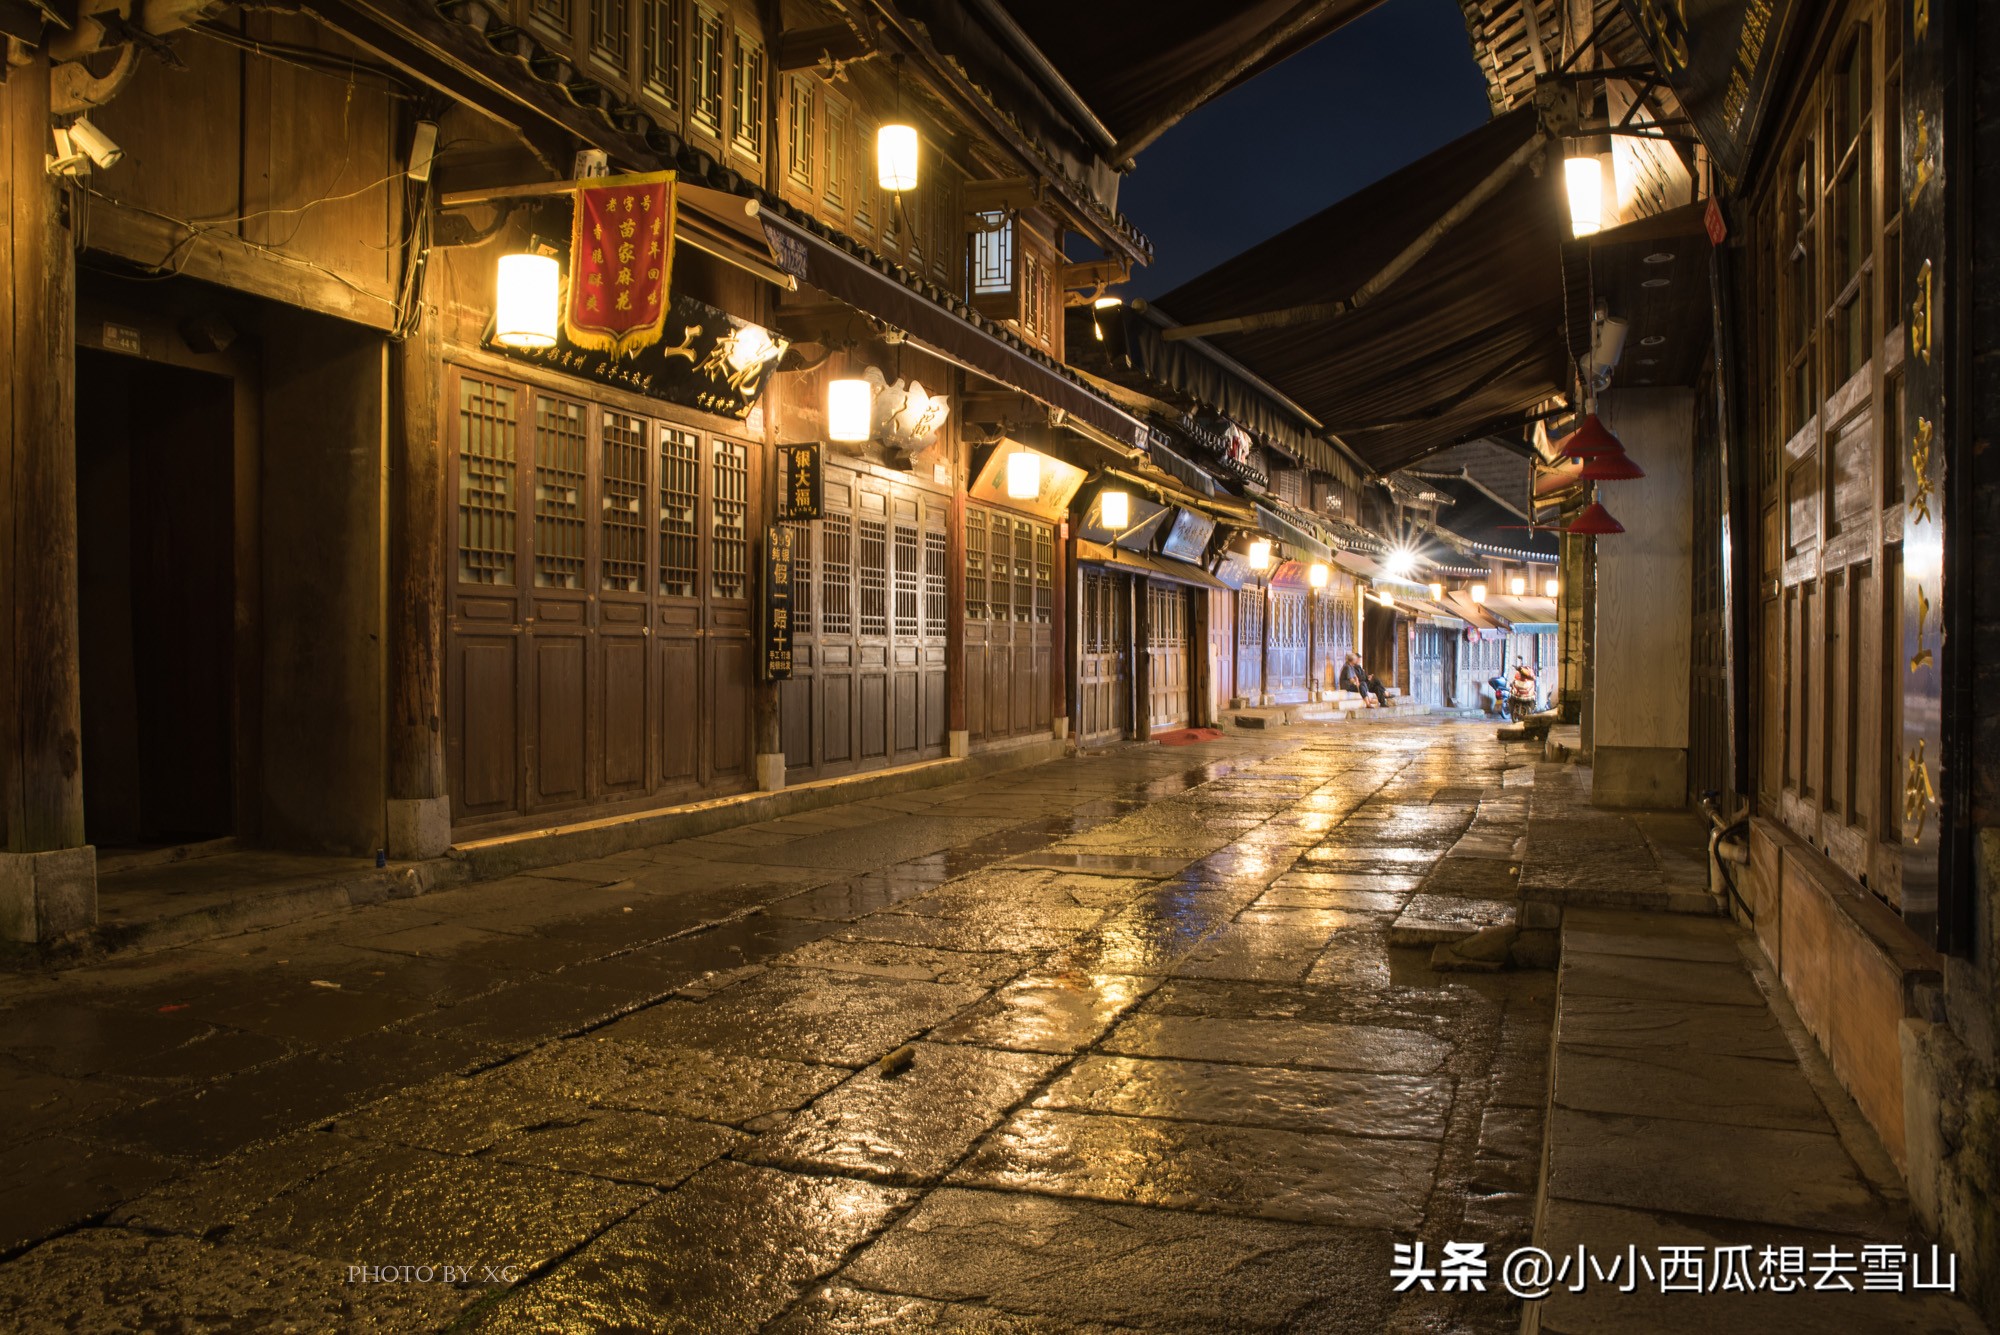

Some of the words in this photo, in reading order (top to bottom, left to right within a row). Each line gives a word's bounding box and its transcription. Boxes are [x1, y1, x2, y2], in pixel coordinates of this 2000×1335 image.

[605, 194, 652, 212] 老字号
[614, 218, 637, 311] 苗家麻花
[647, 216, 662, 305] 童年回味
[795, 450, 811, 506] 银大福
[772, 547, 790, 562] 纯银
[773, 563, 788, 651] 假一赔十
